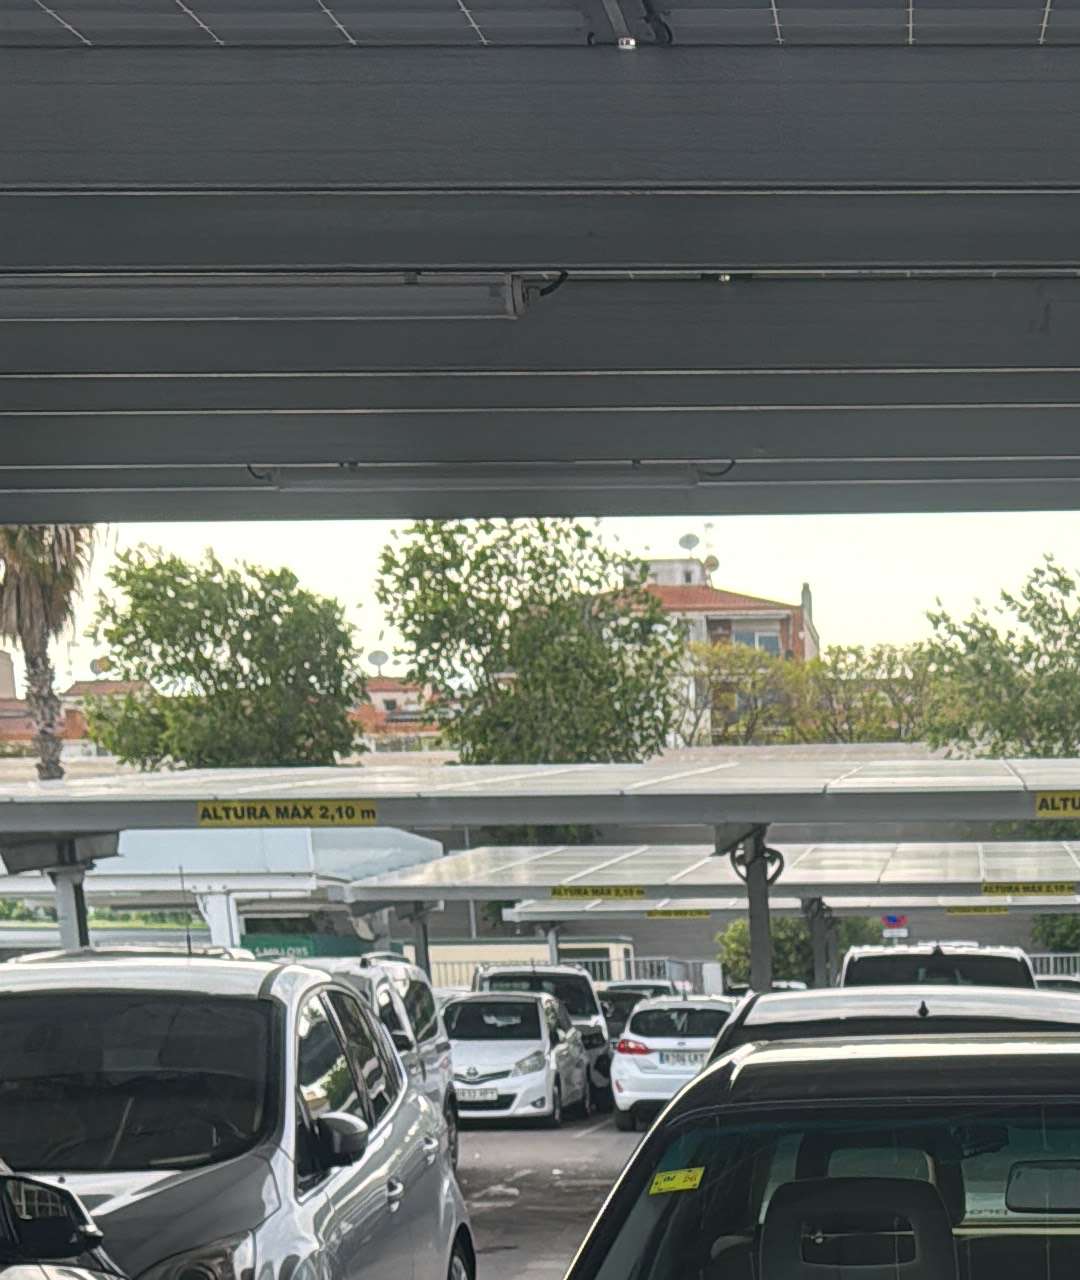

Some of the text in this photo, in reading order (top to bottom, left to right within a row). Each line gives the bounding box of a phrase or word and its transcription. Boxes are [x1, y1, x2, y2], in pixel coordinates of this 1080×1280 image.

[201, 806, 271, 820] ALTURA
[319, 806, 355, 822] 2,10
[361, 808, 376, 819] m
